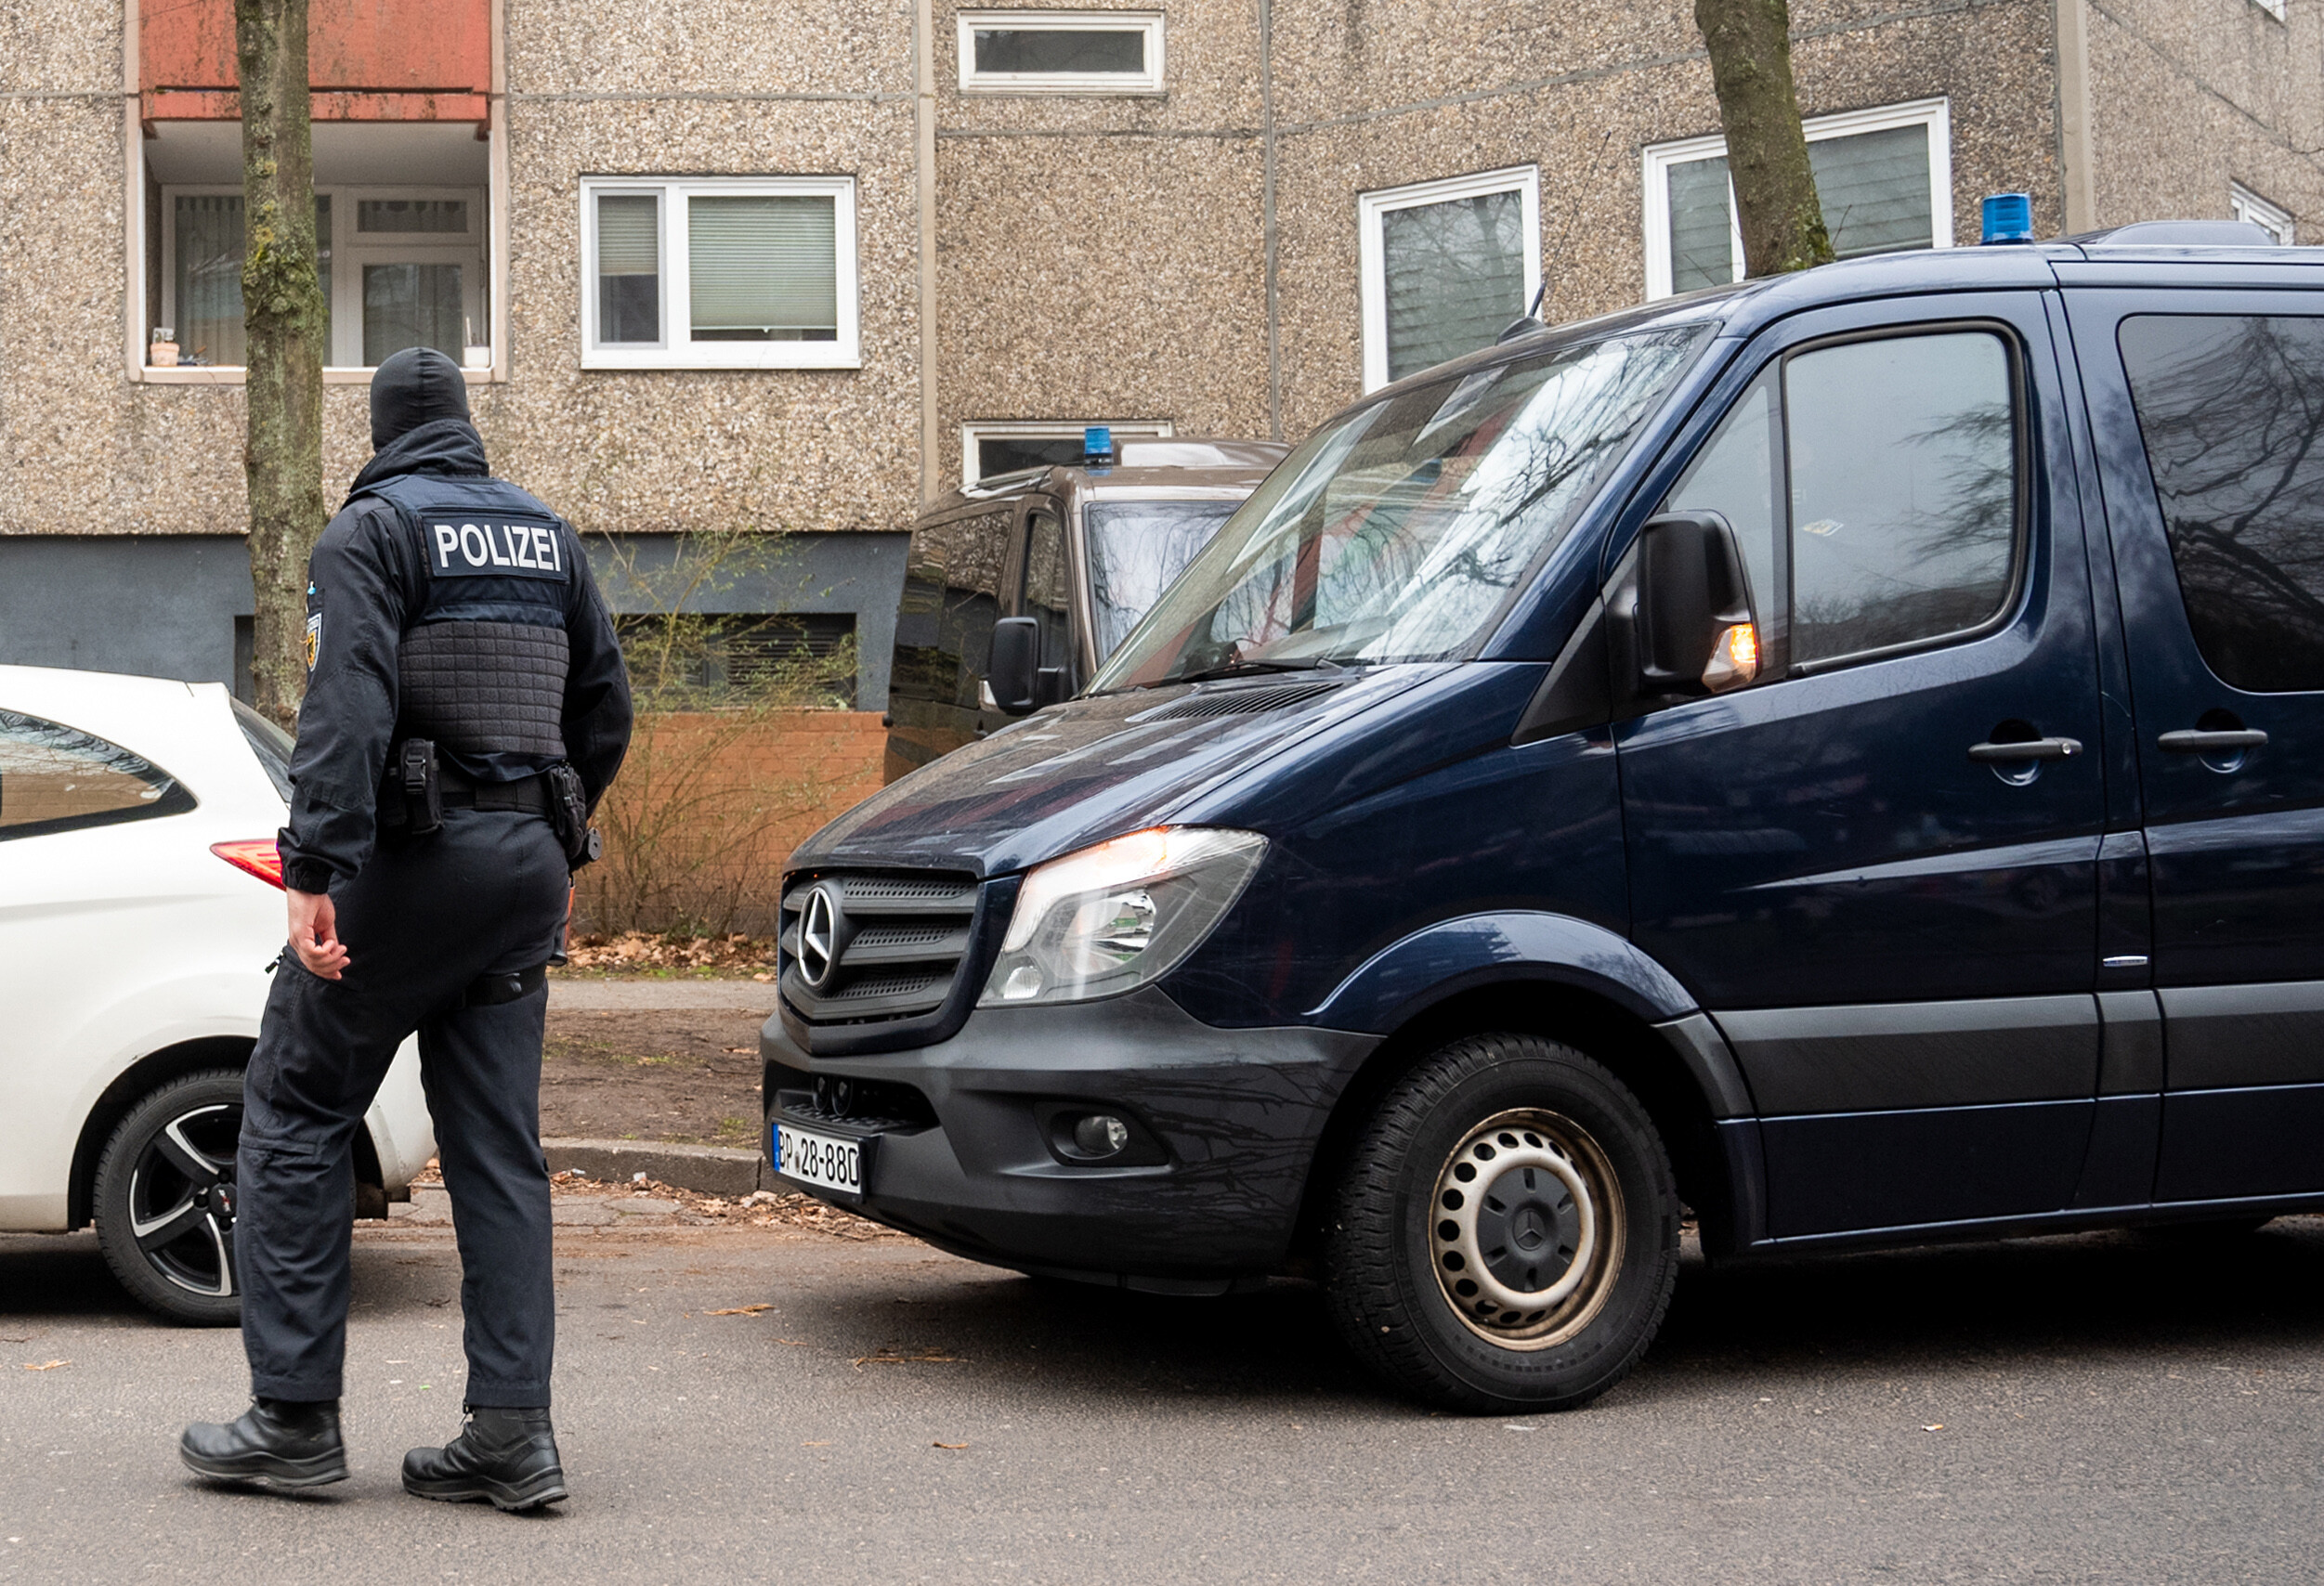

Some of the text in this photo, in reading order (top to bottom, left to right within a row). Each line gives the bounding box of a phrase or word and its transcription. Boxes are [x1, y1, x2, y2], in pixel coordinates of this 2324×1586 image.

[434, 524, 561, 571] POLIZEI
[778, 1130, 860, 1187] BP 28-880
